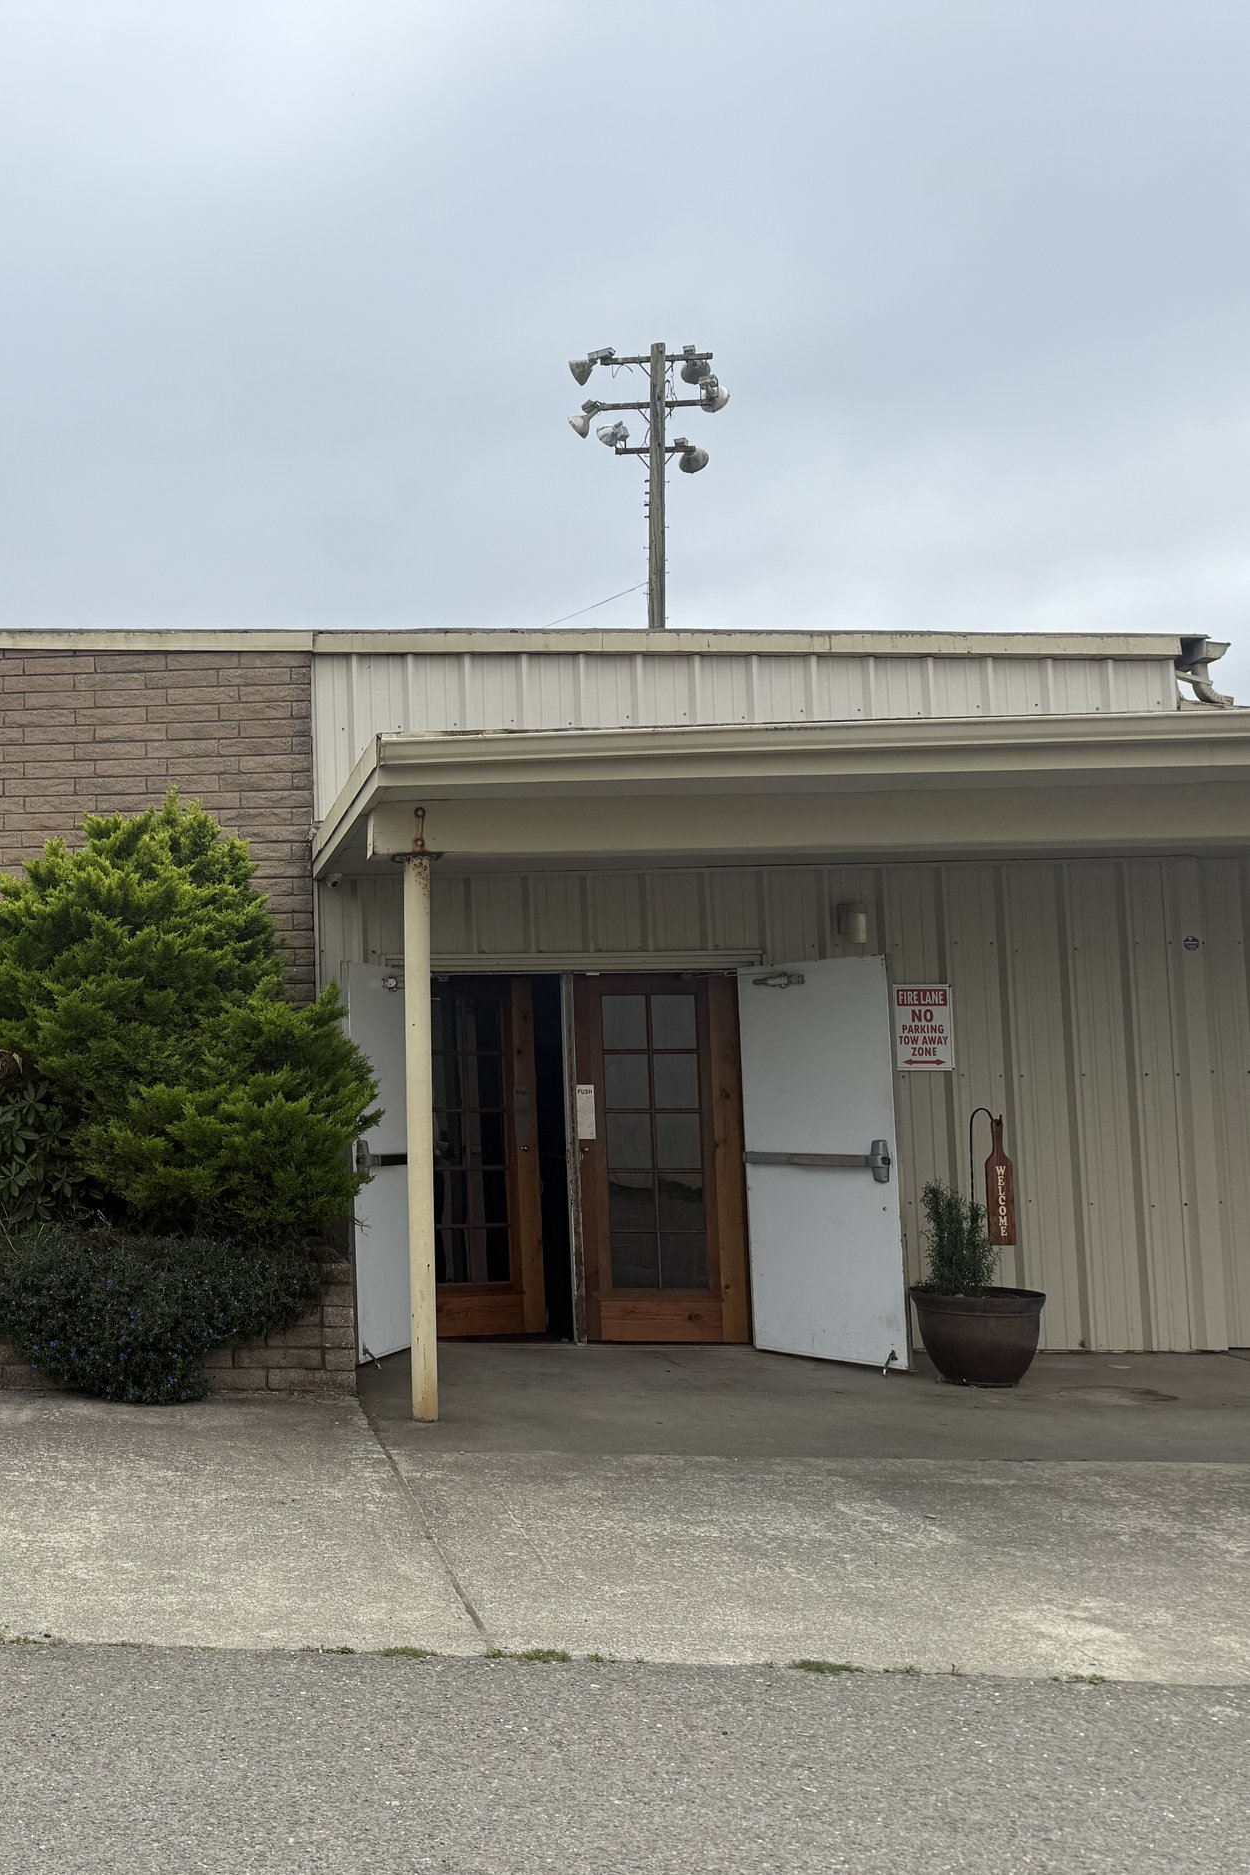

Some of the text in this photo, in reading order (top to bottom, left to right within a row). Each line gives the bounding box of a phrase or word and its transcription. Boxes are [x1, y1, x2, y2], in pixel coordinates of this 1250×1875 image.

[898, 990, 945, 1005] FIRE LANE
[911, 1008, 934, 1023] NO
[902, 1024, 945, 1034] PARKING
[898, 1035, 948, 1045] TOW AWAY
[911, 1046, 938, 1057] ZONE
[995, 1165, 1008, 1237] WELCOME
